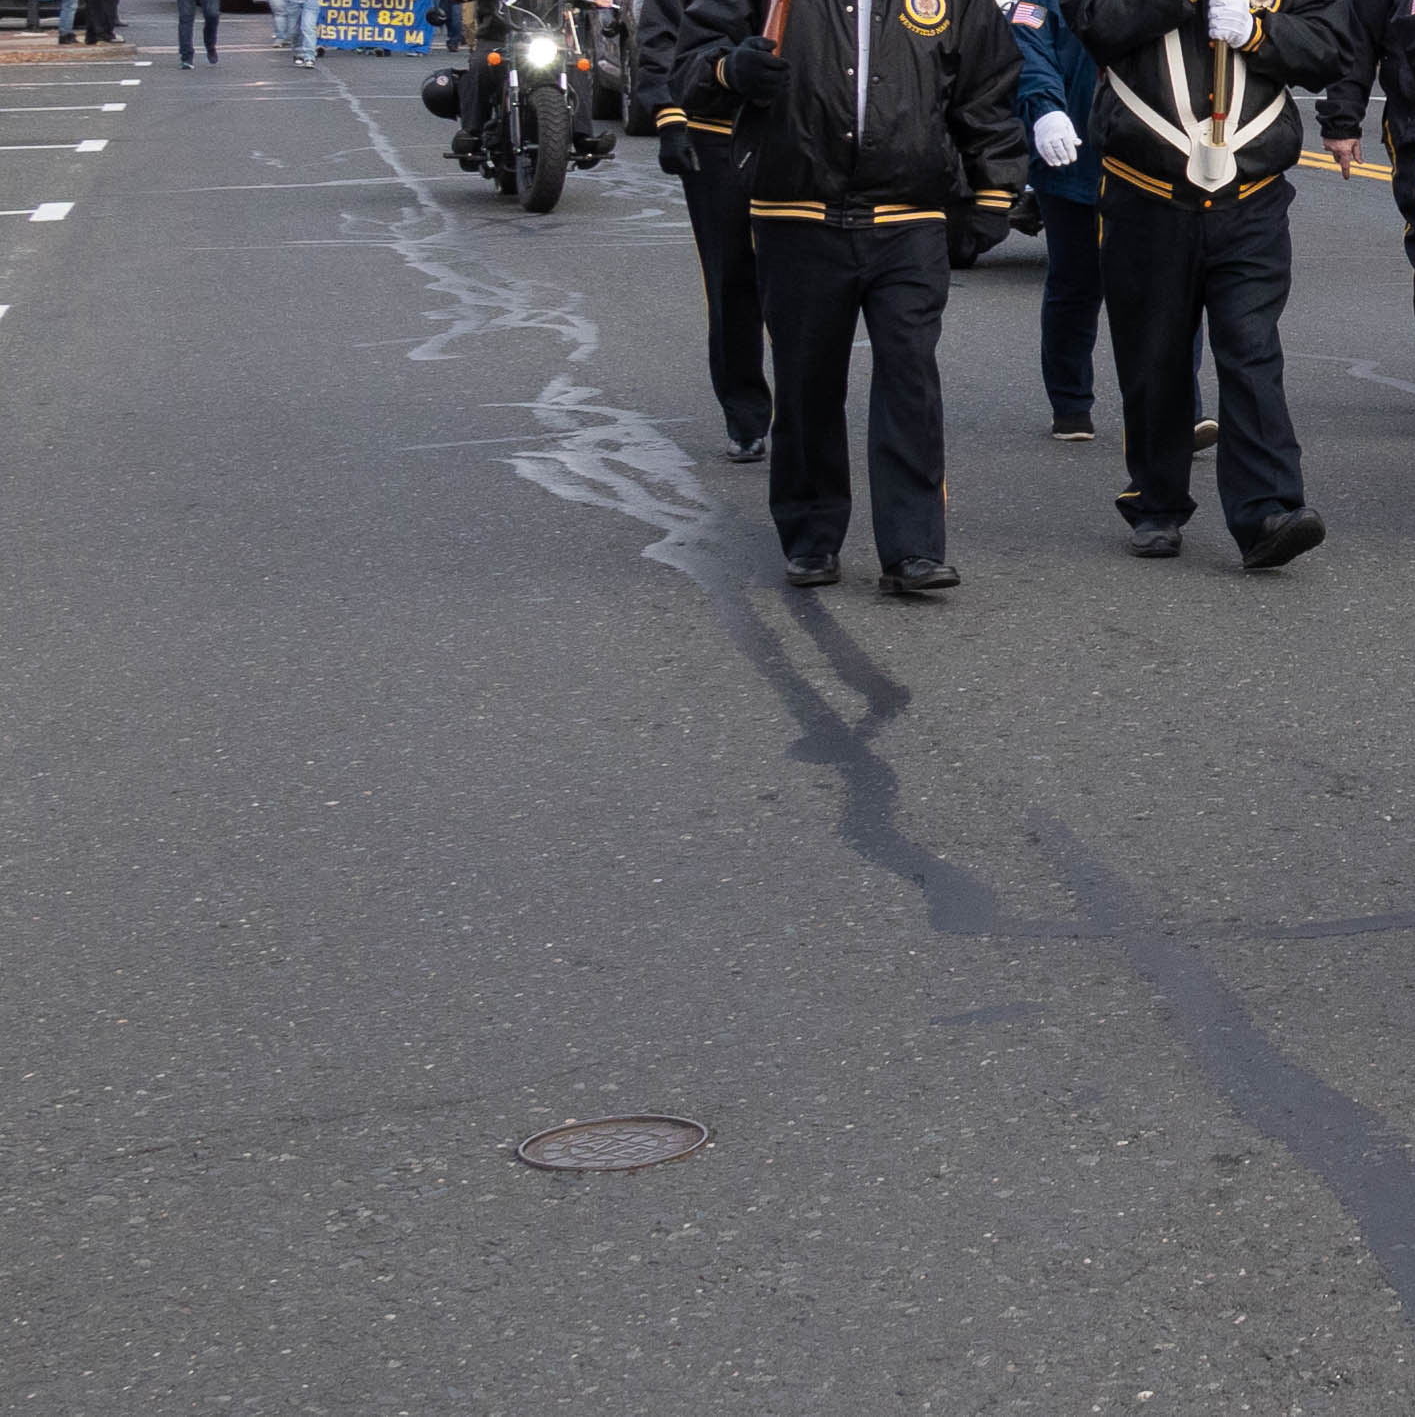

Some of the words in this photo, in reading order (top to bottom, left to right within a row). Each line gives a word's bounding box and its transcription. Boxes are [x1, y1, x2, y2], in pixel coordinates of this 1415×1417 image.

[327, 9, 369, 25] PACK
[378, 9, 415, 27] 820
[405, 29, 424, 45] MA
